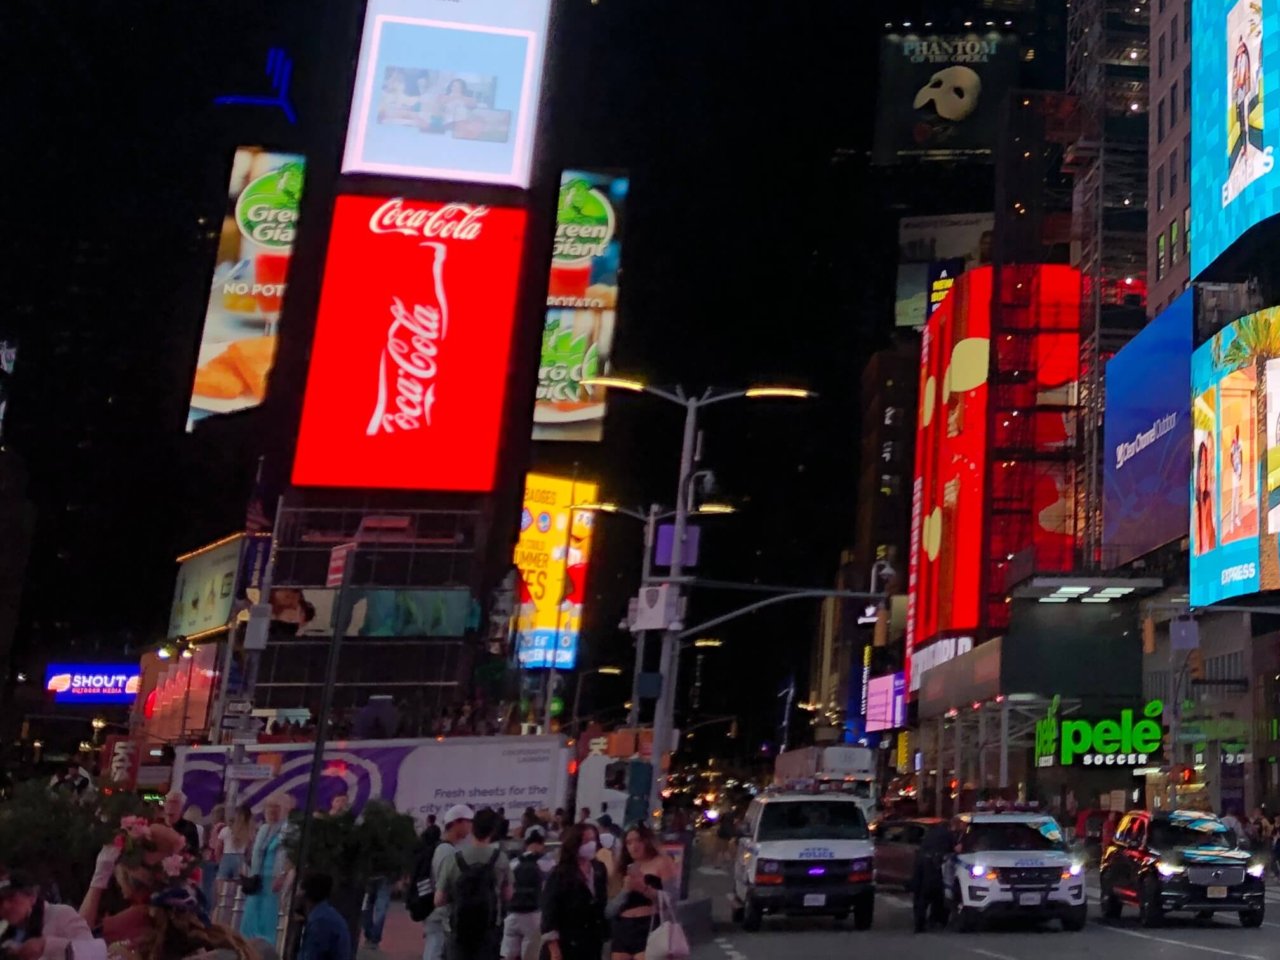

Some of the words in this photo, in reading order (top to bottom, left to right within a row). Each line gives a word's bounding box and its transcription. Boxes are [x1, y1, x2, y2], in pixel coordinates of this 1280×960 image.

[903, 41, 997, 55] PHANTOM
[368, 197, 491, 241] Coca-Cola
[223, 284, 249, 295] NO
[71, 675, 126, 688] SHOUT
[1061, 699, 1164, 765] pelé
[1083, 753, 1149, 765] SOCCER
[434, 788, 466, 799] Fresh
[468, 786, 506, 799] sheets
[508, 785, 527, 796] for
[528, 784, 549, 795] the
[419, 803, 441, 814] city
